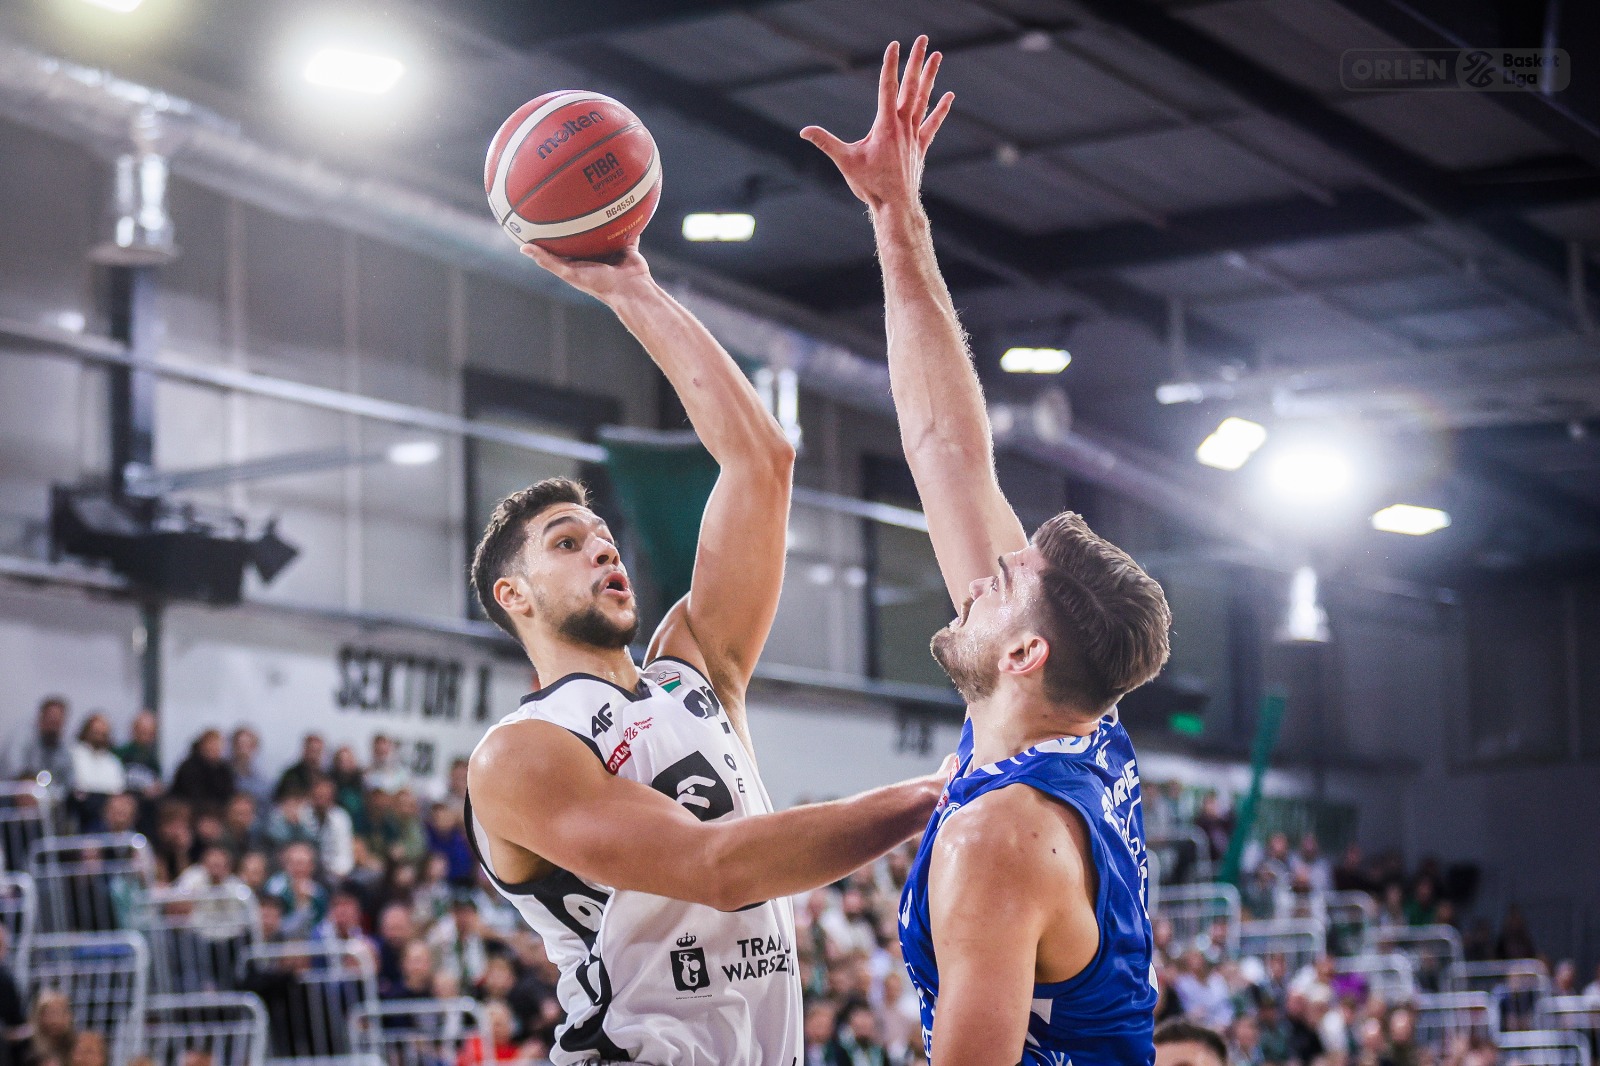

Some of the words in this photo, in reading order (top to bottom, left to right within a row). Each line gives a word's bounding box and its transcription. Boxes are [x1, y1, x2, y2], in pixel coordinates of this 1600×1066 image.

[536, 110, 604, 160] molten
[582, 152, 620, 185] FIBA
[605, 195, 635, 219] BG4550
[591, 702, 613, 739] 4F
